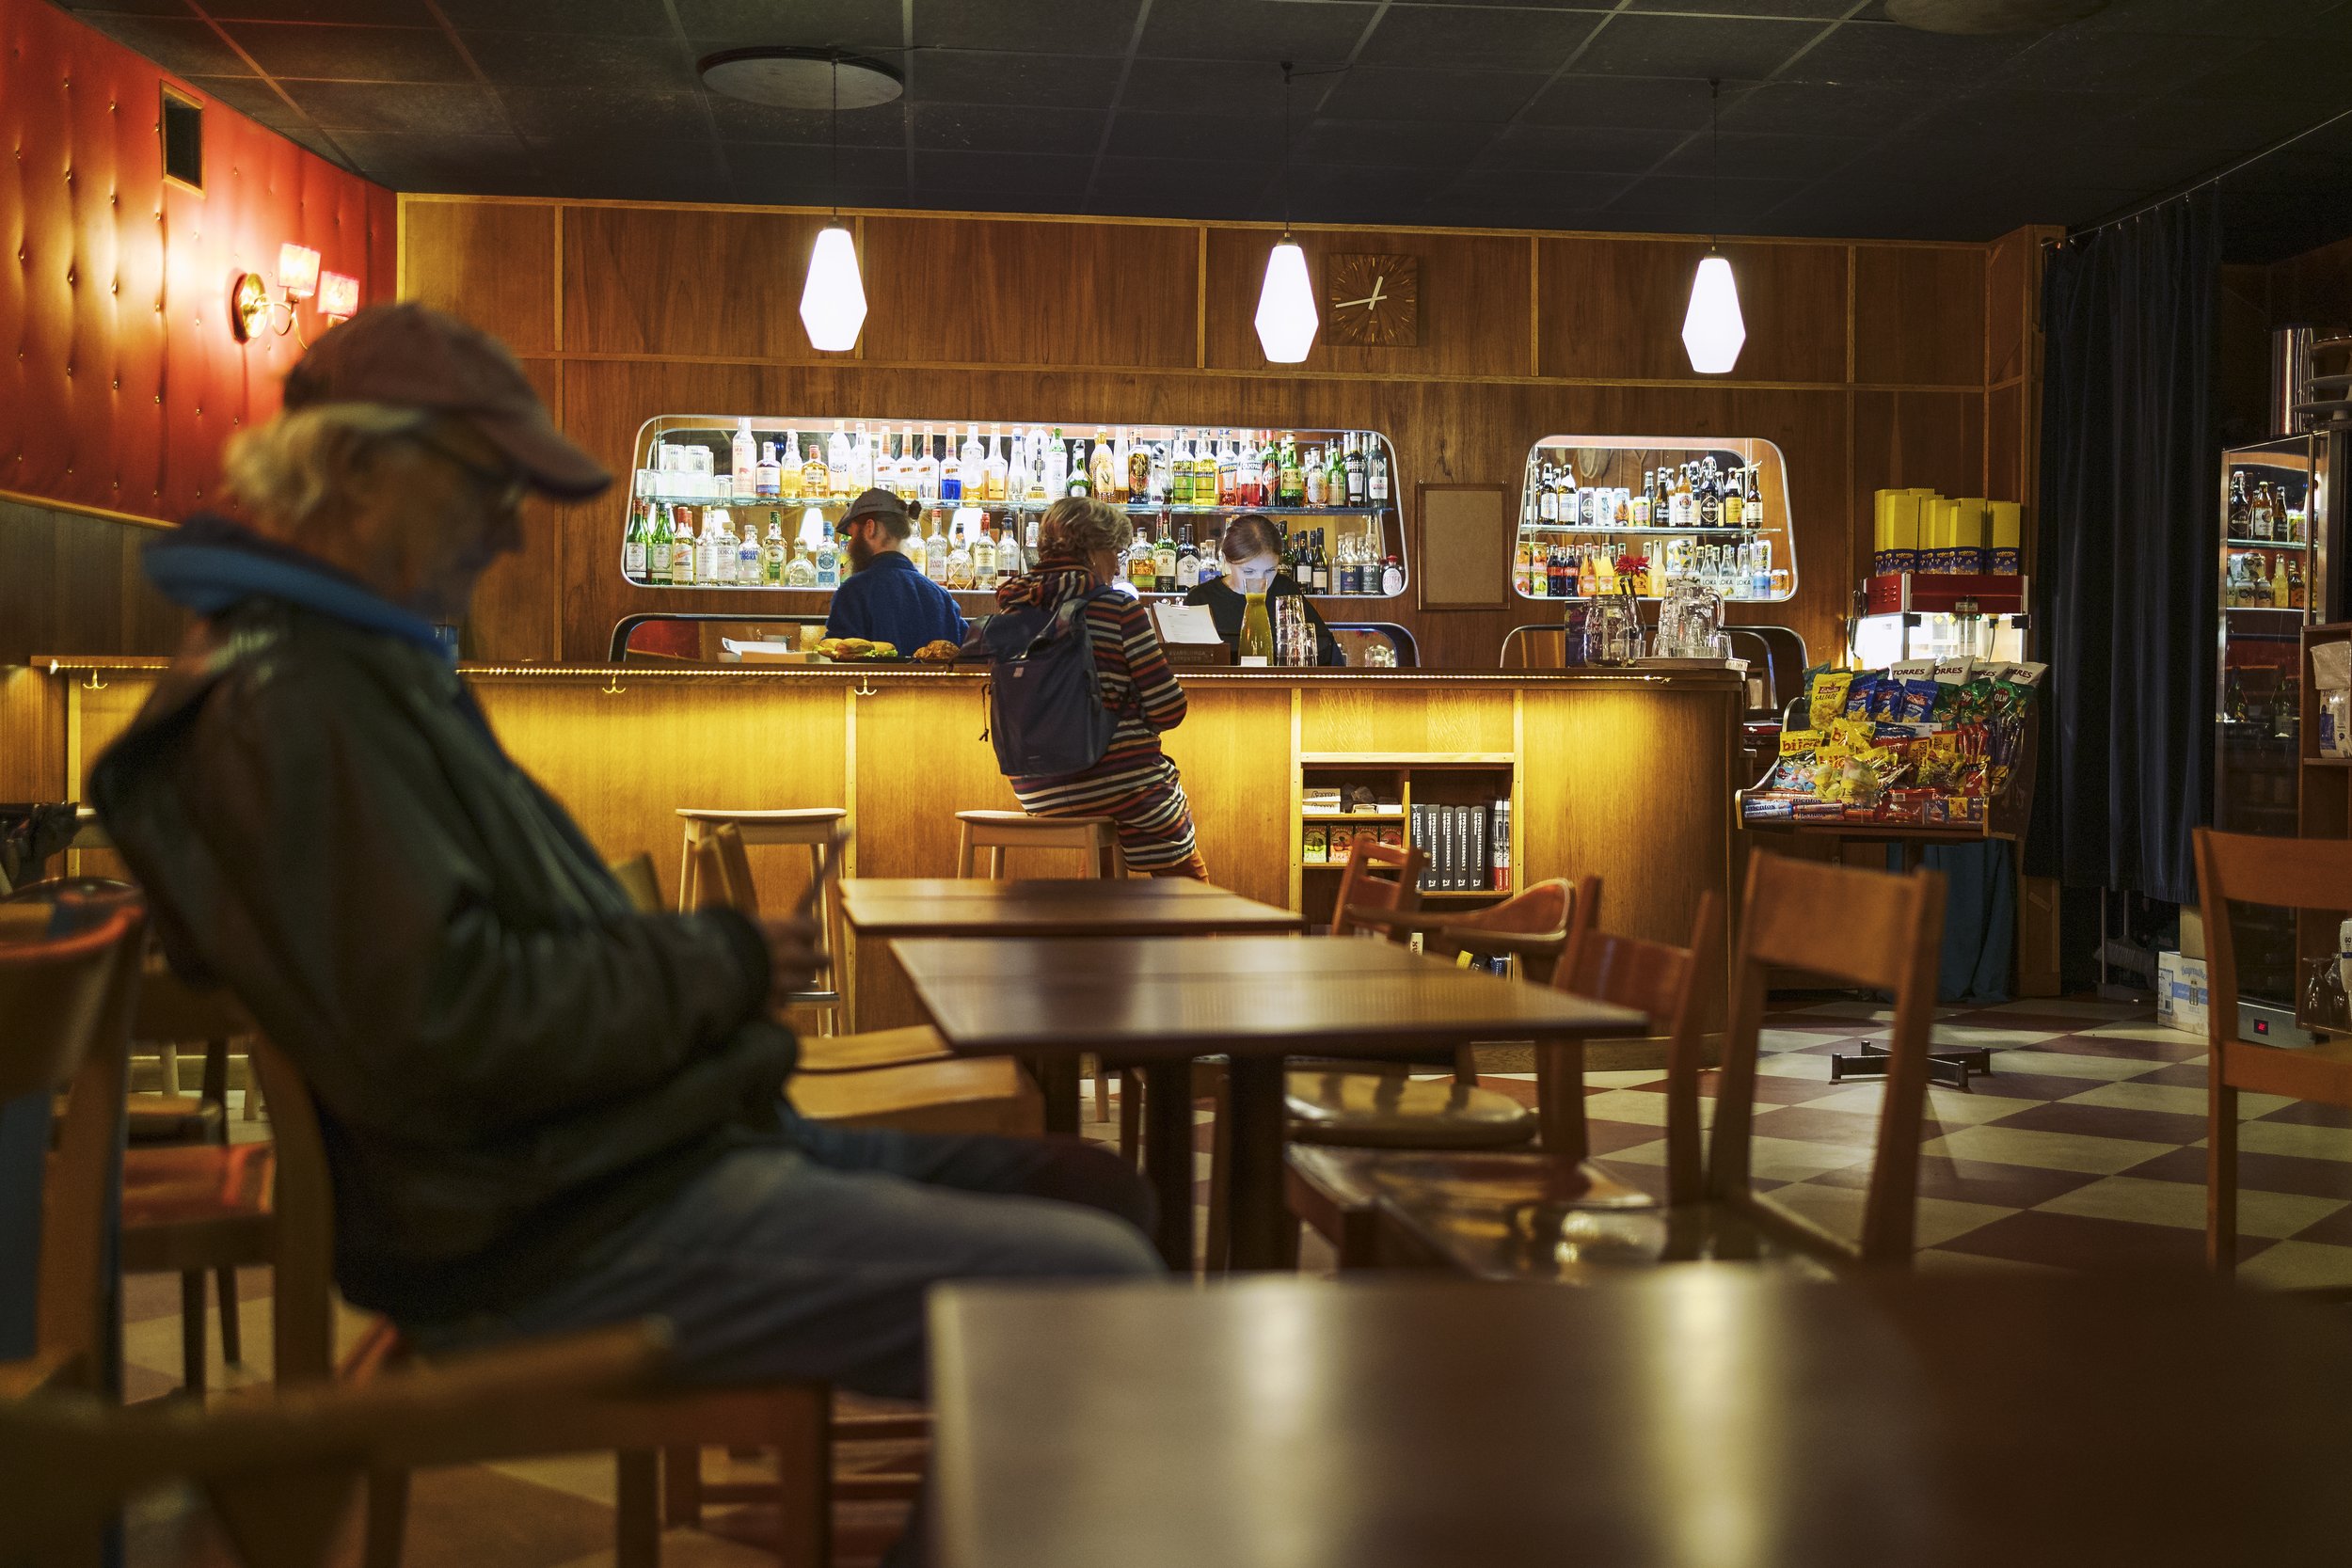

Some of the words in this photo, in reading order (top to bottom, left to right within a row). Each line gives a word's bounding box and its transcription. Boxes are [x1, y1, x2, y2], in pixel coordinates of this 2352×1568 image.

[1893, 668, 1925, 676] TORRES
[1934, 666, 1963, 675] ORRES
[1994, 693, 2009, 703] OLW
[1747, 803, 1776, 812] mentos
